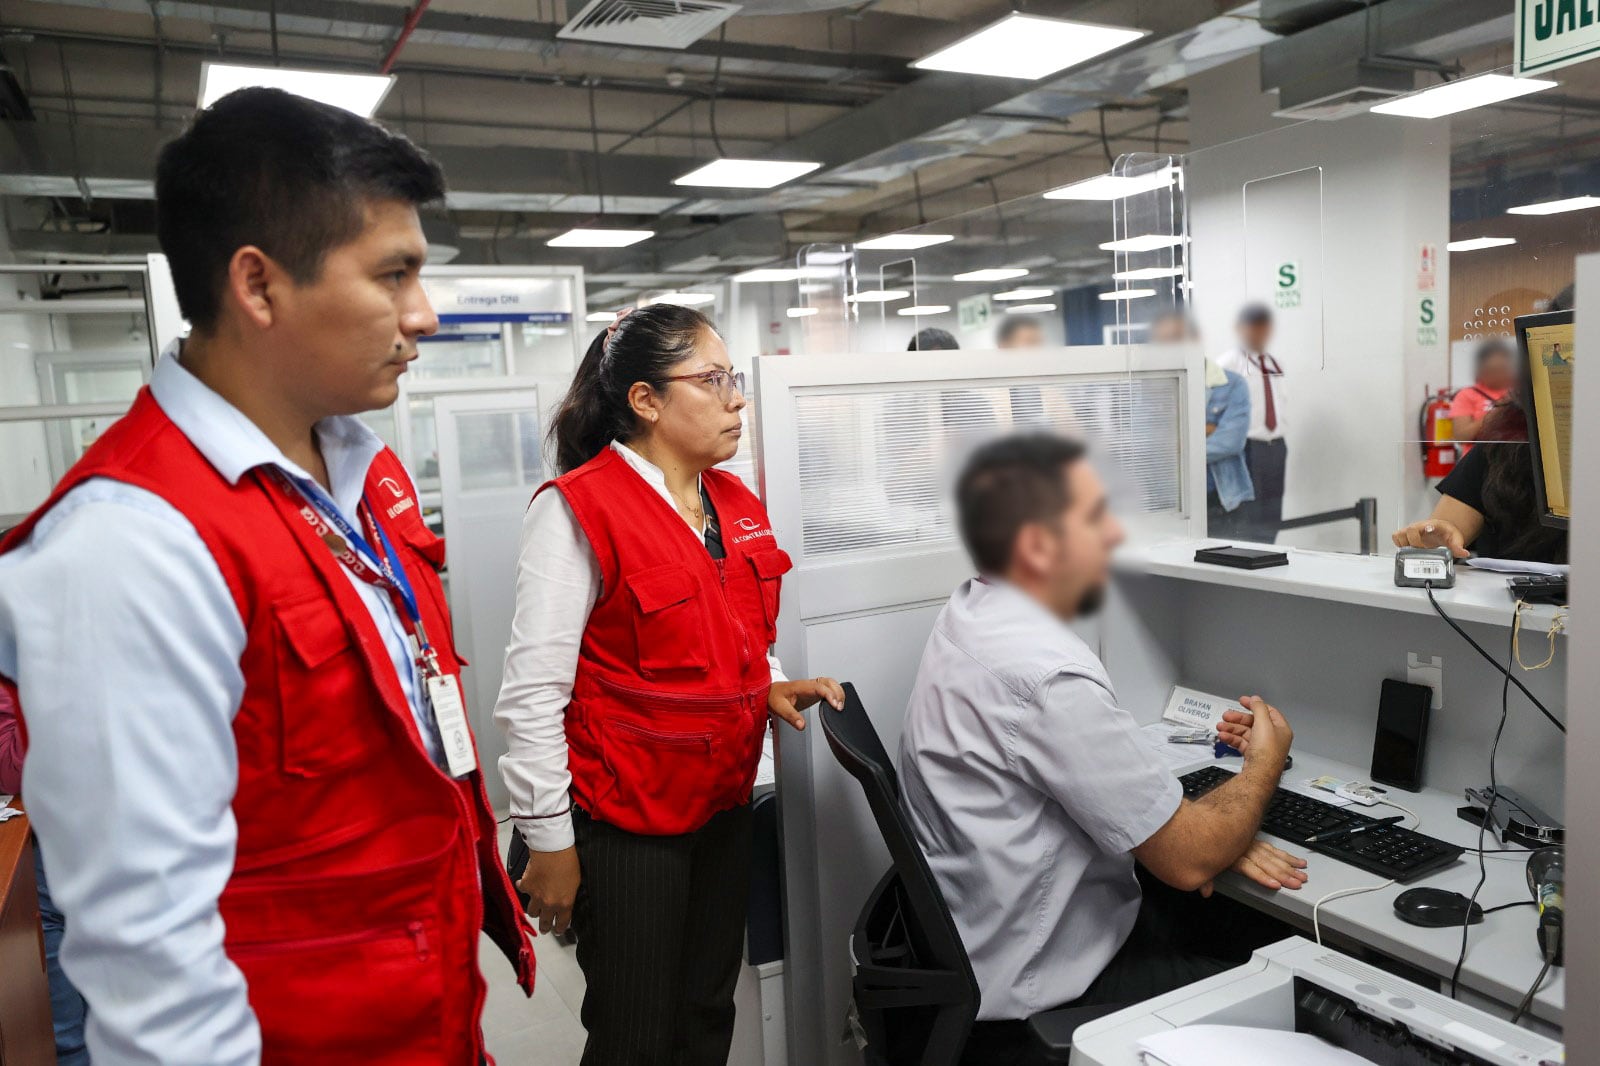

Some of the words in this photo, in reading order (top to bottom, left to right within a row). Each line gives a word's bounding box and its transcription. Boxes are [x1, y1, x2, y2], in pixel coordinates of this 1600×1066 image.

[1279, 264, 1296, 287] S
[1420, 299, 1433, 324] S
[1178, 706, 1210, 720] OLIVEROS
[1184, 698, 1211, 711] BRAYAN
